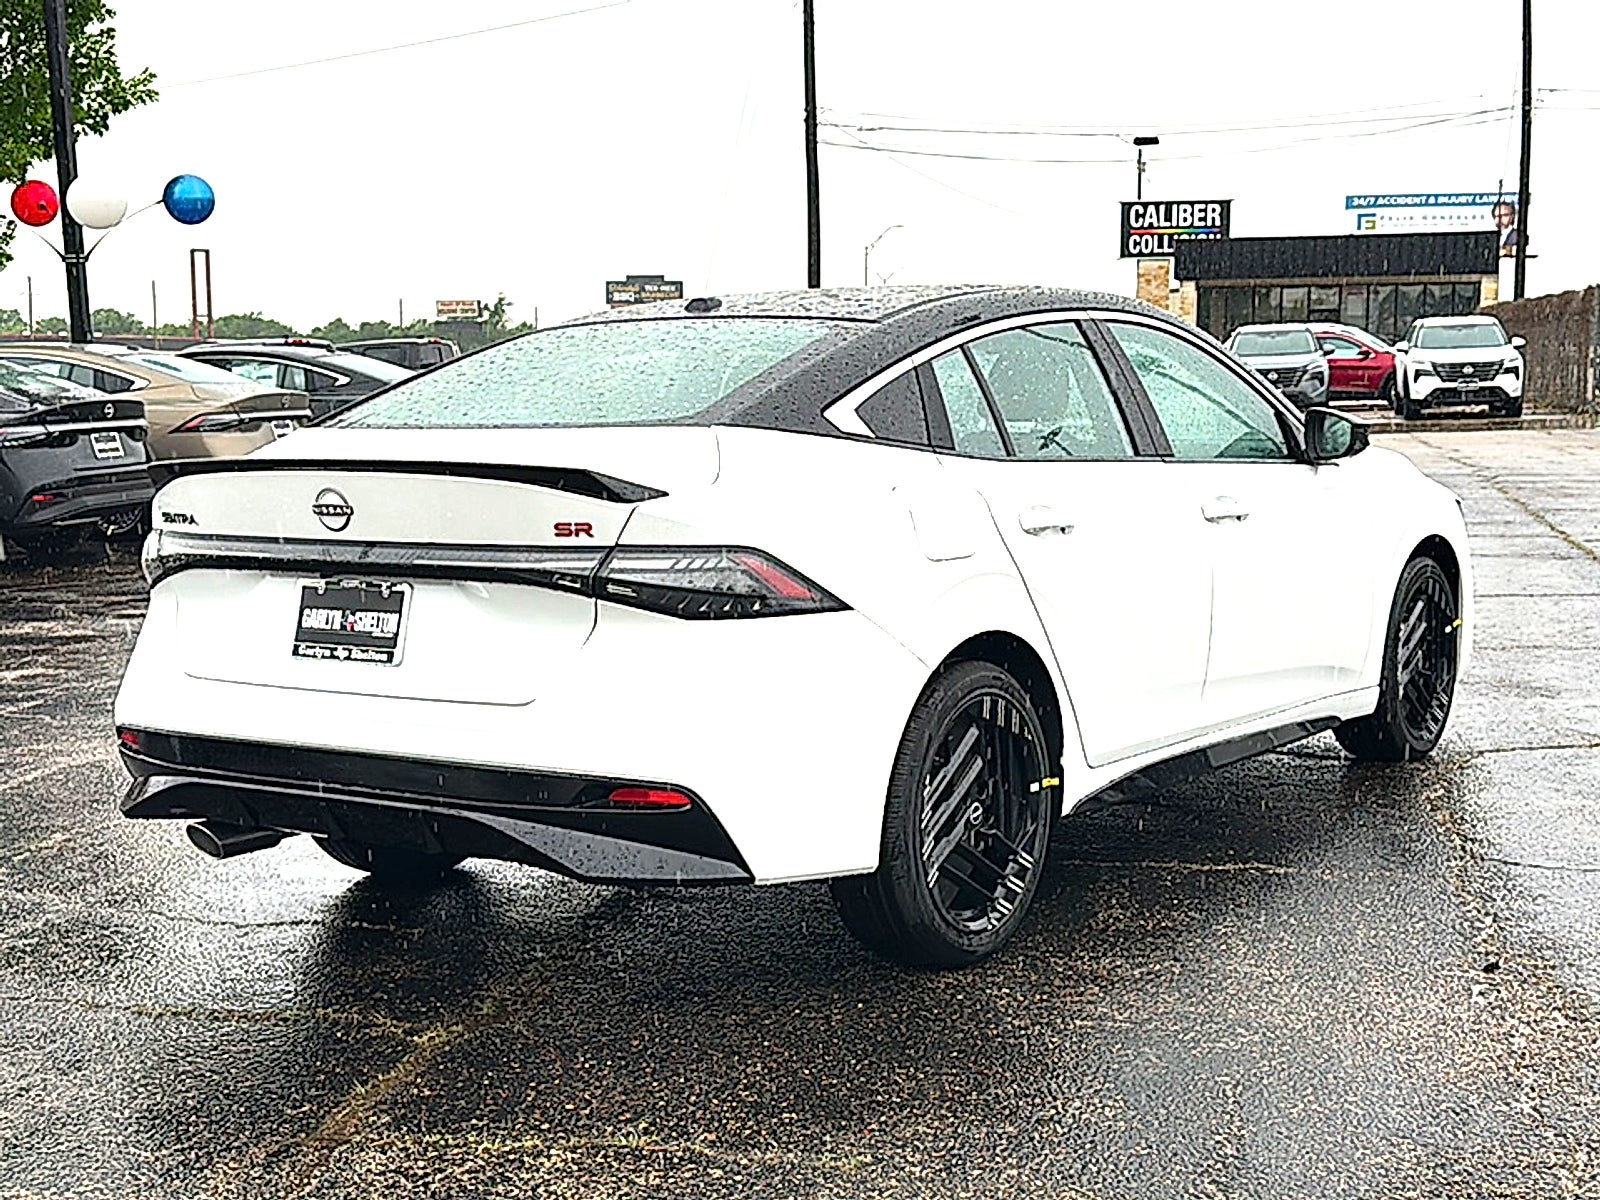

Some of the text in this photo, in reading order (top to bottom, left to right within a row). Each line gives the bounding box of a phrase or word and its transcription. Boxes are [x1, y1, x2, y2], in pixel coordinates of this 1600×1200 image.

[1376, 195, 1427, 205] ACCIDENT
[1129, 203, 1222, 228] CALIBER
[313, 505, 352, 515] NISSAN
[553, 522, 594, 538] SR
[353, 611, 400, 634] SHELTON
